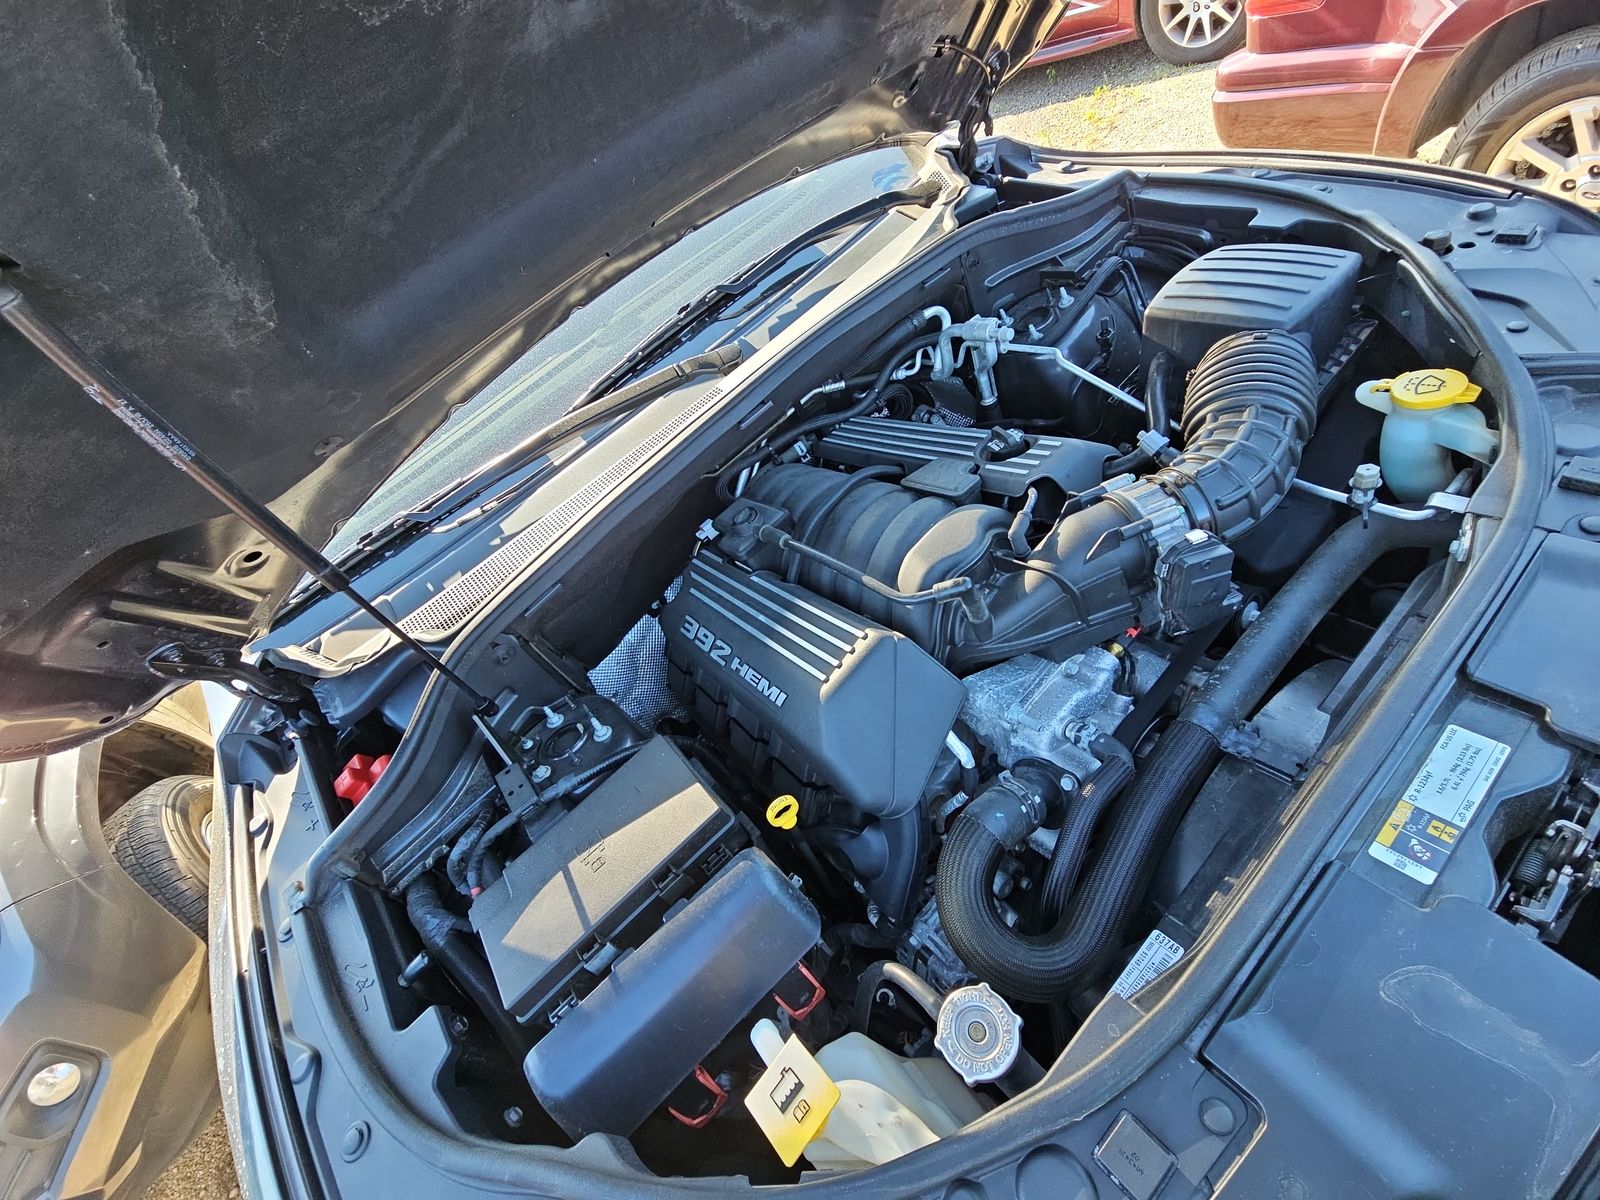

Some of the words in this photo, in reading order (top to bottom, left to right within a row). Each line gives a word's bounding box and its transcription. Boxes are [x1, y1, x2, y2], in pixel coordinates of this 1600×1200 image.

[680, 615, 732, 666] 392
[731, 657, 788, 707] HEMI
[1440, 740, 1449, 750] FCA
[1414, 770, 1433, 794] R-1234yf
[1462, 798, 1475, 812] PAG
[1154, 933, 1180, 954] 637AB
[943, 1007, 953, 1038] KEEP
[956, 1054, 970, 1068] DO
[973, 1060, 994, 1073] NOT
